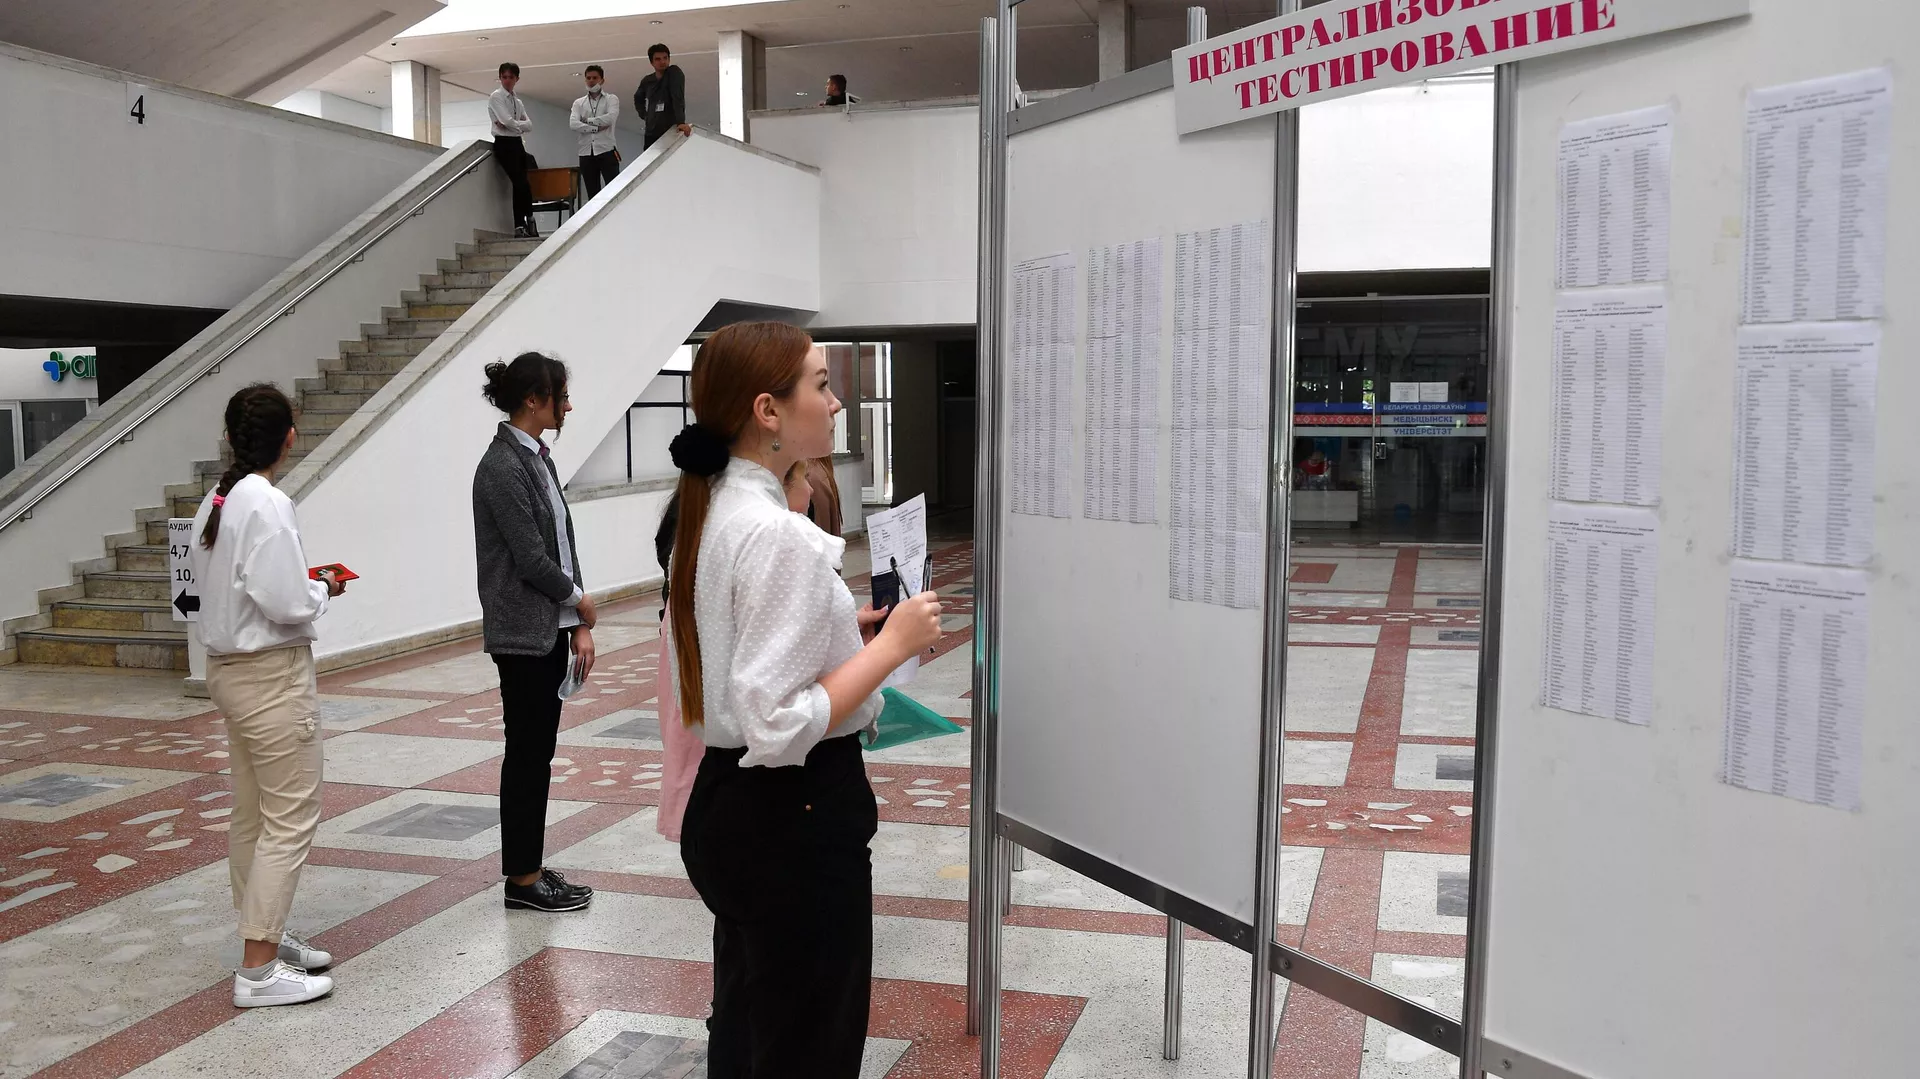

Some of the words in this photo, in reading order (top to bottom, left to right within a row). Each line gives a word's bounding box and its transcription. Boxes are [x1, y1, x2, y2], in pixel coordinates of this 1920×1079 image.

[1235, 0, 1616, 110] ТЕСТИРОВАНИЕ
[130, 94, 146, 125] 4
[170, 544, 190, 560] 4,7
[175, 568, 195, 584] 10,
